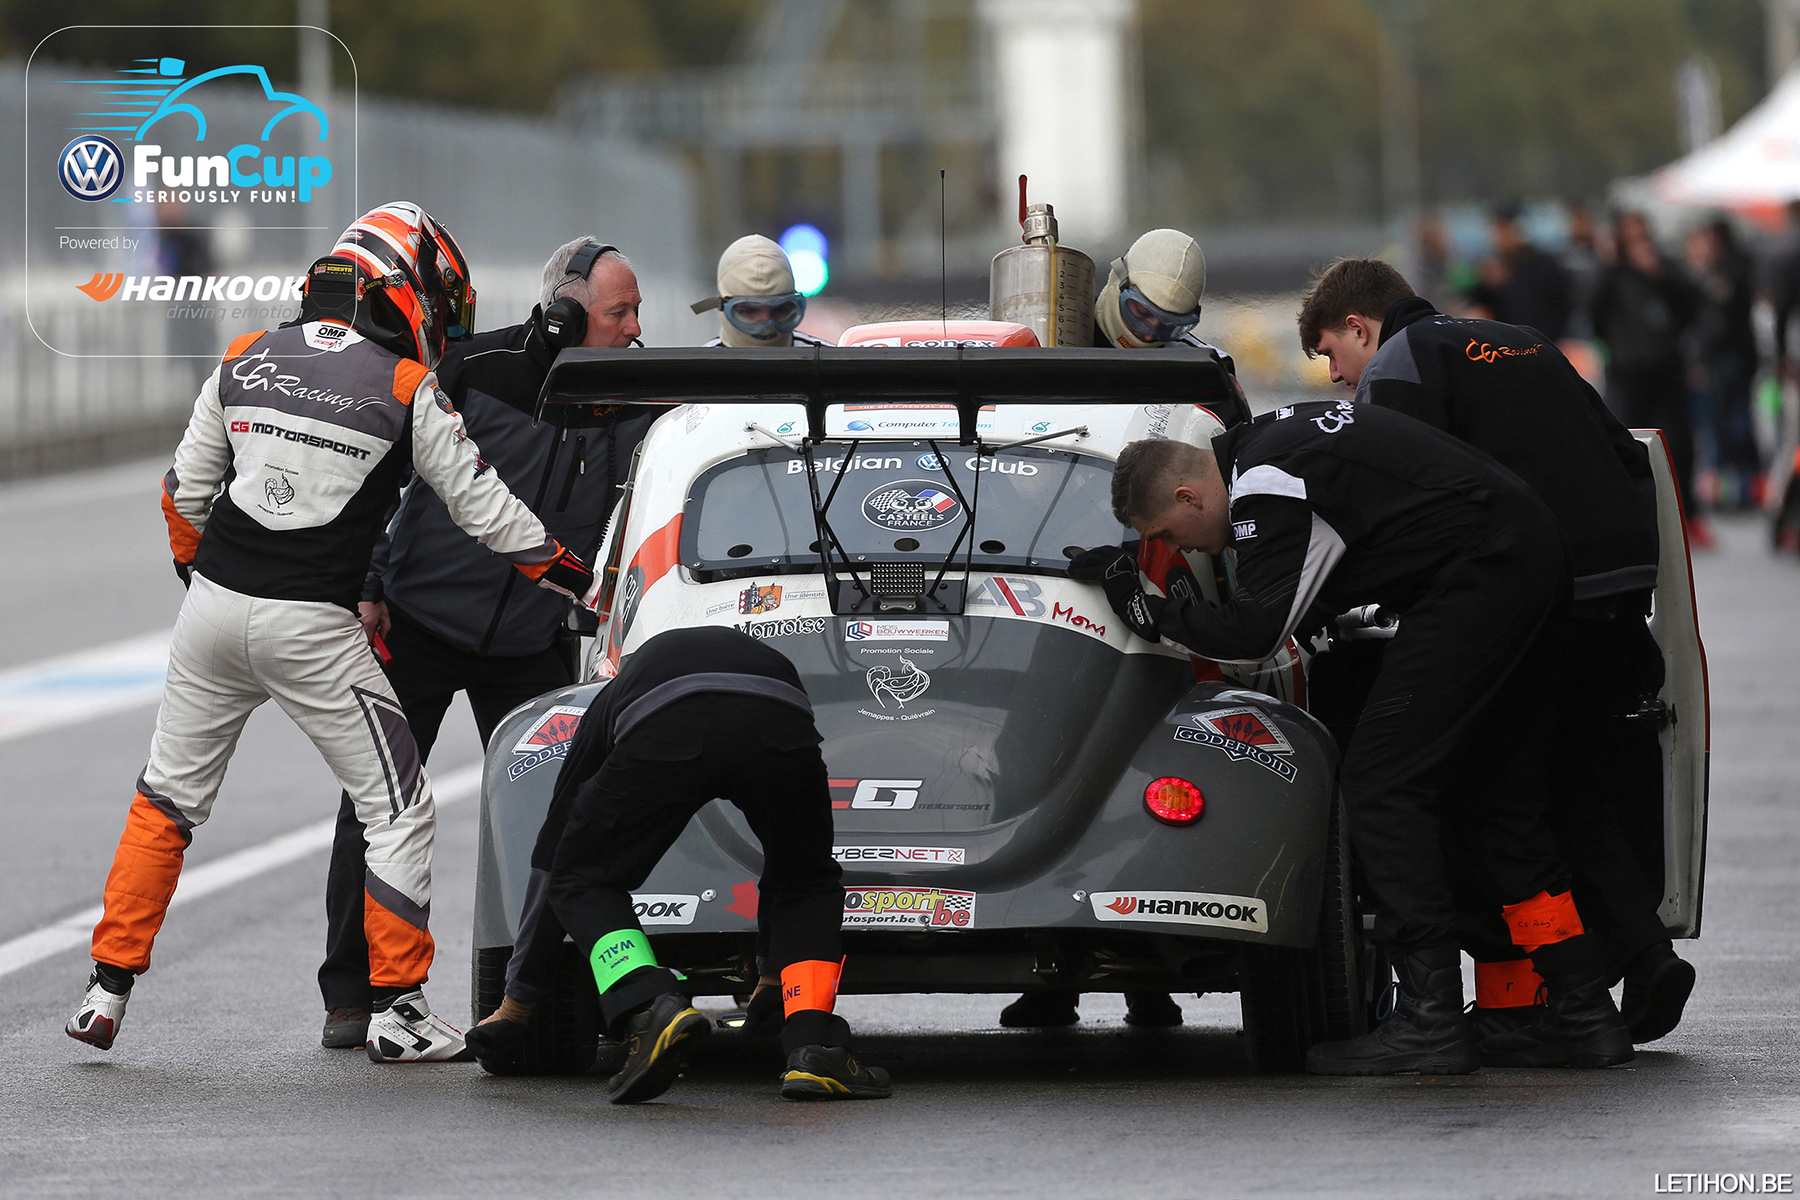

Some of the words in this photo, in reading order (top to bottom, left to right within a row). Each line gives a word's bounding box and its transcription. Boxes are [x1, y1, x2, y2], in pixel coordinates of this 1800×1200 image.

[318, 327, 347, 339] OMP
[269, 375, 354, 414] Racing
[878, 421, 938, 429] Computer
[230, 421, 250, 433] CG
[251, 422, 371, 461] MOTORSPORT
[787, 456, 903, 475] Belgian
[965, 457, 1039, 476] Club
[876, 513, 945, 522] CASTEELS
[734, 615, 826, 640] Montoise
[857, 708, 895, 721] Jemappes
[900, 708, 936, 721] Quiévrain
[511, 740, 573, 776] GODEF
[1179, 729, 1291, 775] GODEFROID
[917, 802, 990, 811] motorsport
[832, 848, 945, 861] YBERNET
[845, 889, 946, 914] osport
[842, 915, 916, 924] utosport.be
[598, 939, 635, 964] WALL
